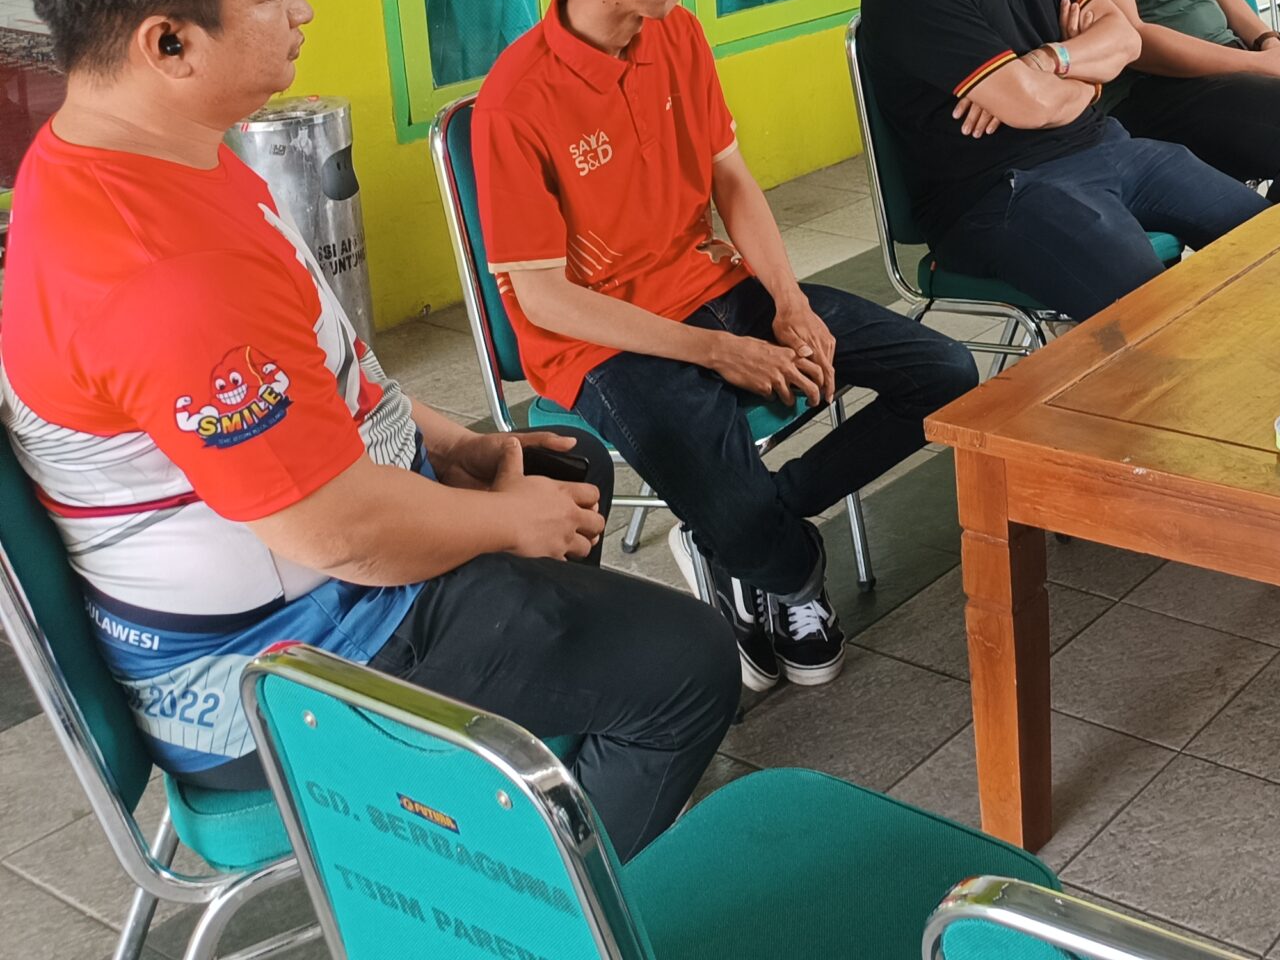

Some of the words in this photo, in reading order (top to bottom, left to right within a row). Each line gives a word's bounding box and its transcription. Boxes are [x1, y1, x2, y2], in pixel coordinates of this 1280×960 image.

[569, 128, 609, 158] SAYA
[575, 144, 613, 176] S&D
[198, 385, 282, 436] SMILE
[143, 685, 220, 728] 2022
[306, 780, 360, 822] GD.
